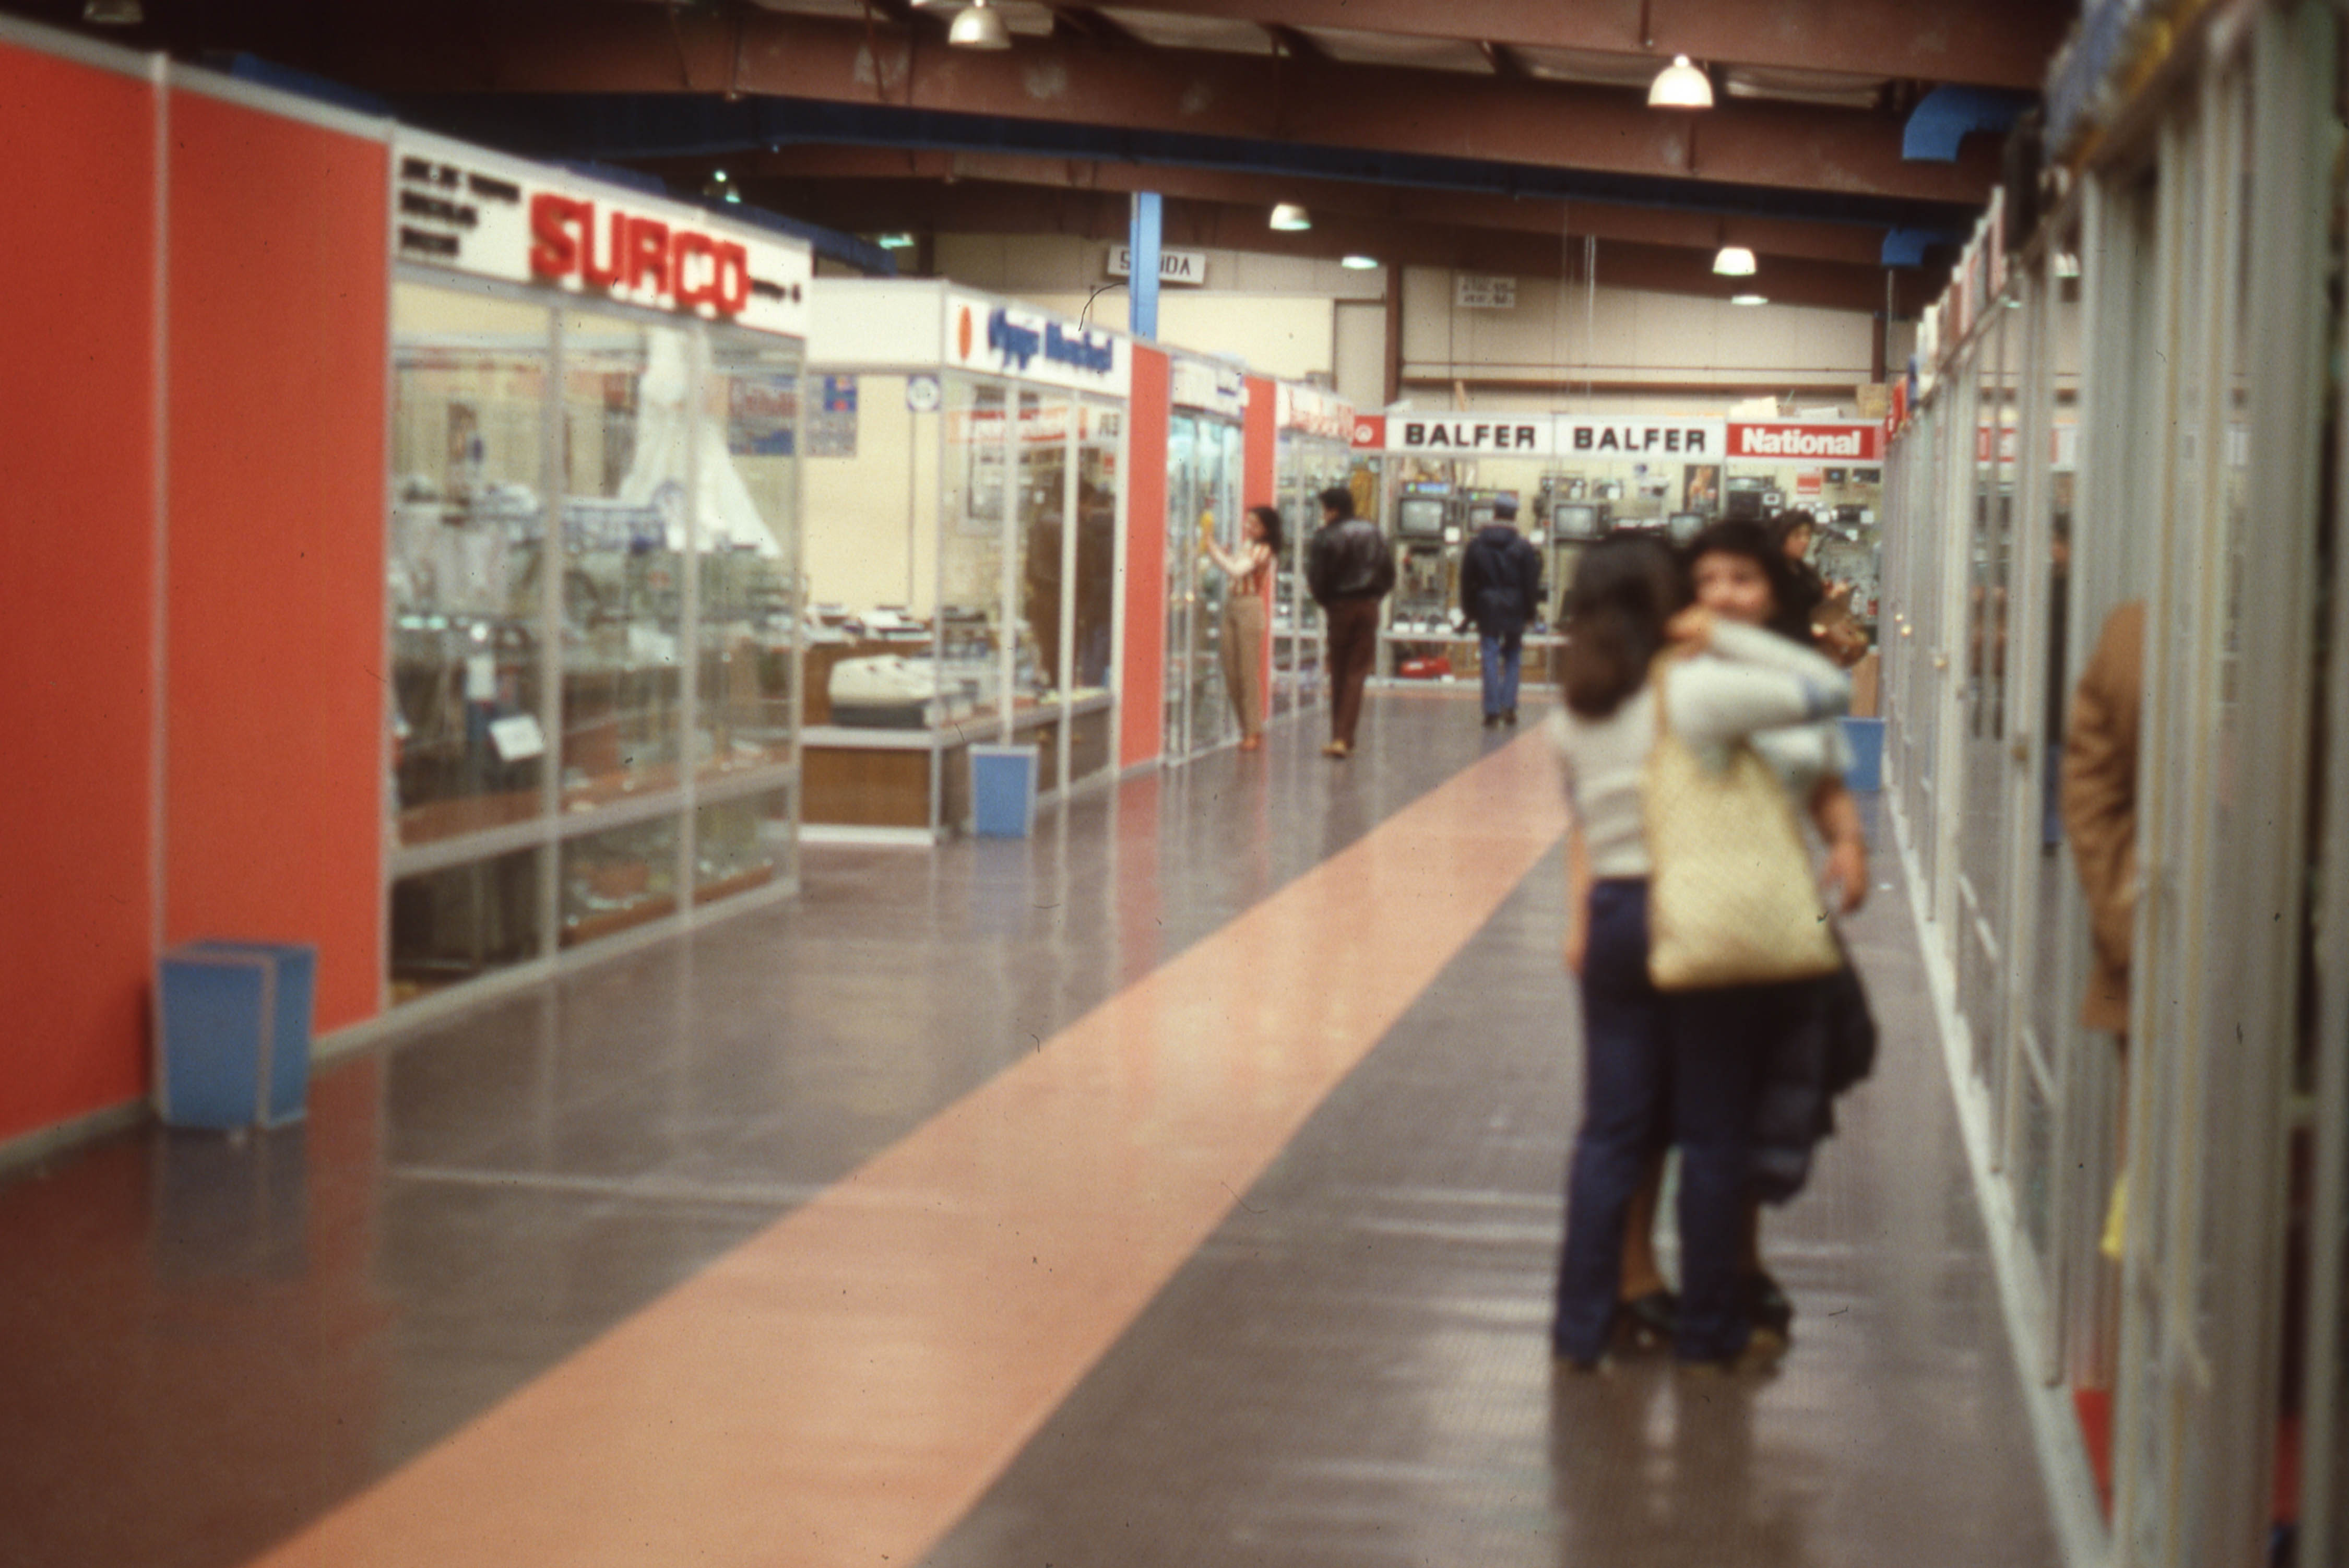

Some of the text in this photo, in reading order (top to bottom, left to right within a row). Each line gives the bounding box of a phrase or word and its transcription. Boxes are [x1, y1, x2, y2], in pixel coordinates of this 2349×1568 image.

[529, 193, 751, 315] SURCO
[1120, 251, 1191, 276] SIDA
[1405, 423, 1535, 449] BALFER
[1574, 427, 1706, 452] BALFER
[1741, 426, 1861, 455] National
